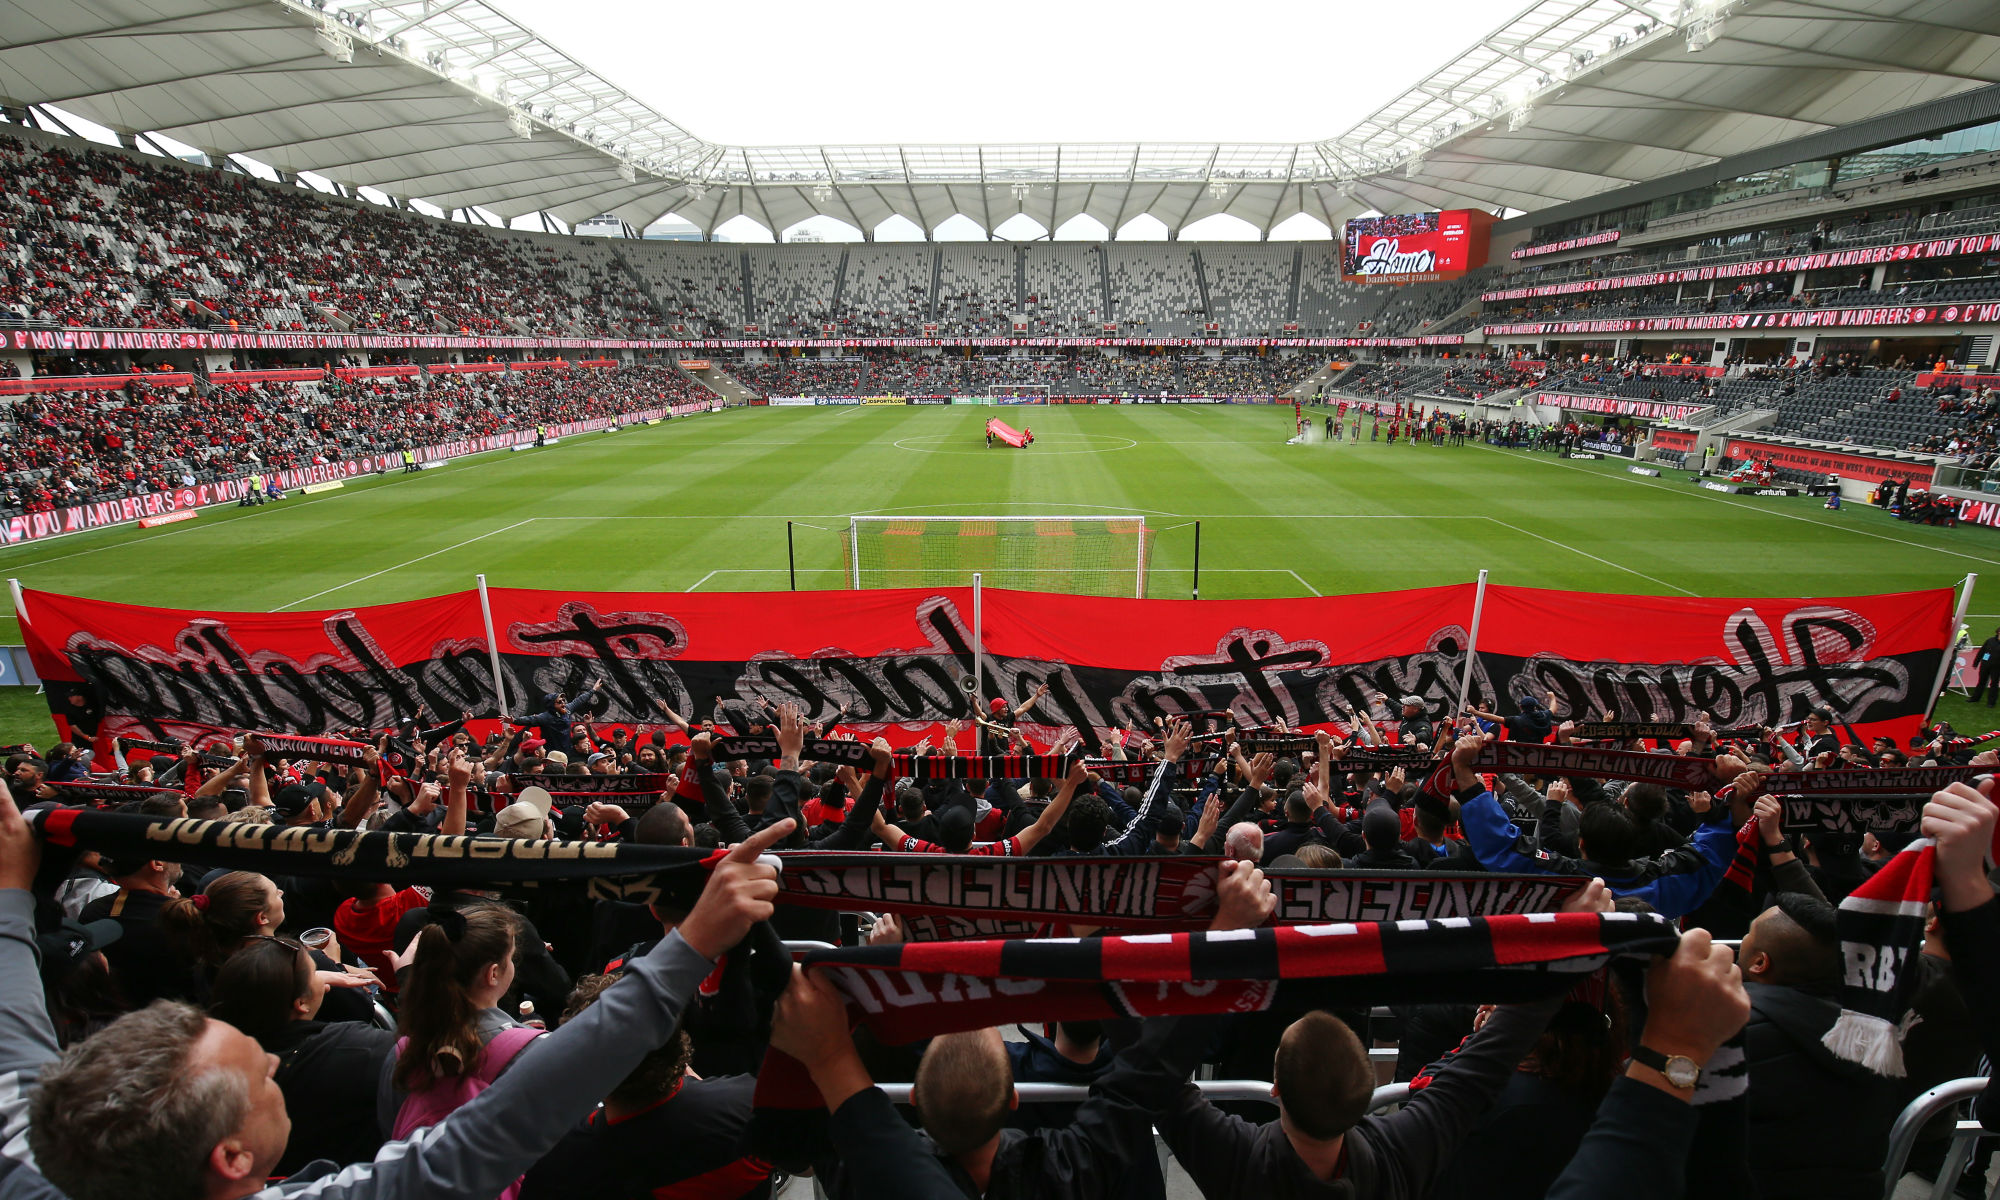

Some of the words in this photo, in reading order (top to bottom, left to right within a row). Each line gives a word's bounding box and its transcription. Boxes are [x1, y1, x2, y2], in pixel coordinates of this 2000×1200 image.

[1700, 267, 1714, 280] YOU
[1716, 262, 1762, 279] WANDERERS
[1808, 254, 1827, 269] YOU
[1831, 246, 1893, 267] WANDERERS
[1914, 240, 1955, 259] C'MON
[1960, 236, 1987, 255] YOU
[1366, 274, 1409, 283] bankwest
[1671, 317, 1684, 330] YOU
[1687, 316, 1732, 329] WANDERERS
[1781, 312, 1813, 327] C'MON
[1817, 310, 1837, 325] YOU
[1841, 308, 1910, 325] WANDERERS
[15, 331, 64, 349] C'MON
[72, 332, 99, 349] YOU
[105, 332, 181, 349] WANDERERS
[200, 334, 232, 348] C'MON
[237, 334, 257, 348] YOU
[260, 334, 314, 348] WANDERERS
[346, 336, 360, 348] YOU
[362, 336, 403, 348] WANDERERS
[957, 339, 969, 347] YOU
[972, 339, 1009, 347] WANDERERS
[1538, 393, 1555, 406] C'MON
[1558, 395, 1569, 407] YOU
[1571, 396, 1609, 412] WANDERERS
[1610, 399, 1633, 414] C'MON
[1635, 402, 1650, 416] YOU
[374, 452, 403, 471] C'MON
[425, 442, 469, 462] WANDERERS
[1570, 452, 1595, 460] Centuria
[1833, 460, 1844, 470] THE
[19, 511, 61, 539] YOU
[70, 491, 175, 530] WANDERERS
[200, 478, 248, 505] C'MON
[280, 462, 347, 489] WANDERERS
[1789, 800, 1813, 820] W
